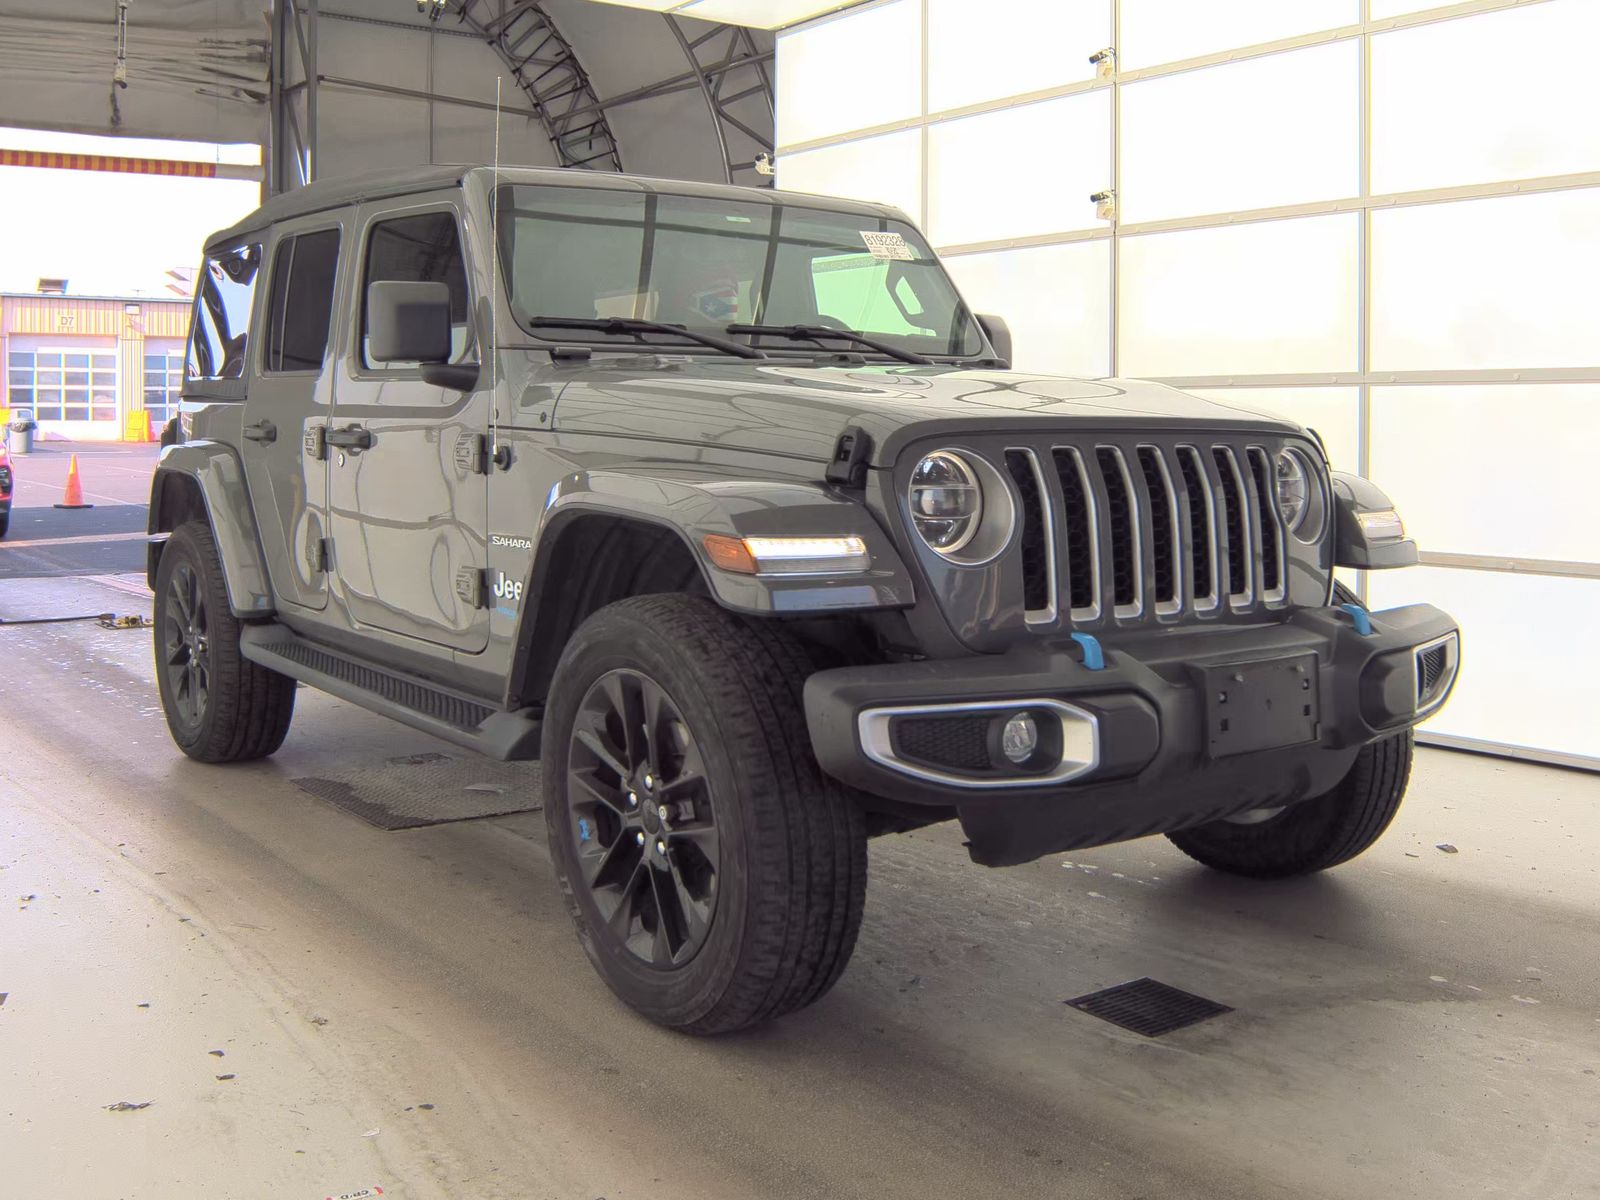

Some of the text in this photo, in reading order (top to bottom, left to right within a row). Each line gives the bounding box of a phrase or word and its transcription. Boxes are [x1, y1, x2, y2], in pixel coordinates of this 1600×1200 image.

[60, 316, 74, 326] D7
[492, 536, 532, 549] SAHARA
[493, 572, 523, 601] Jee
